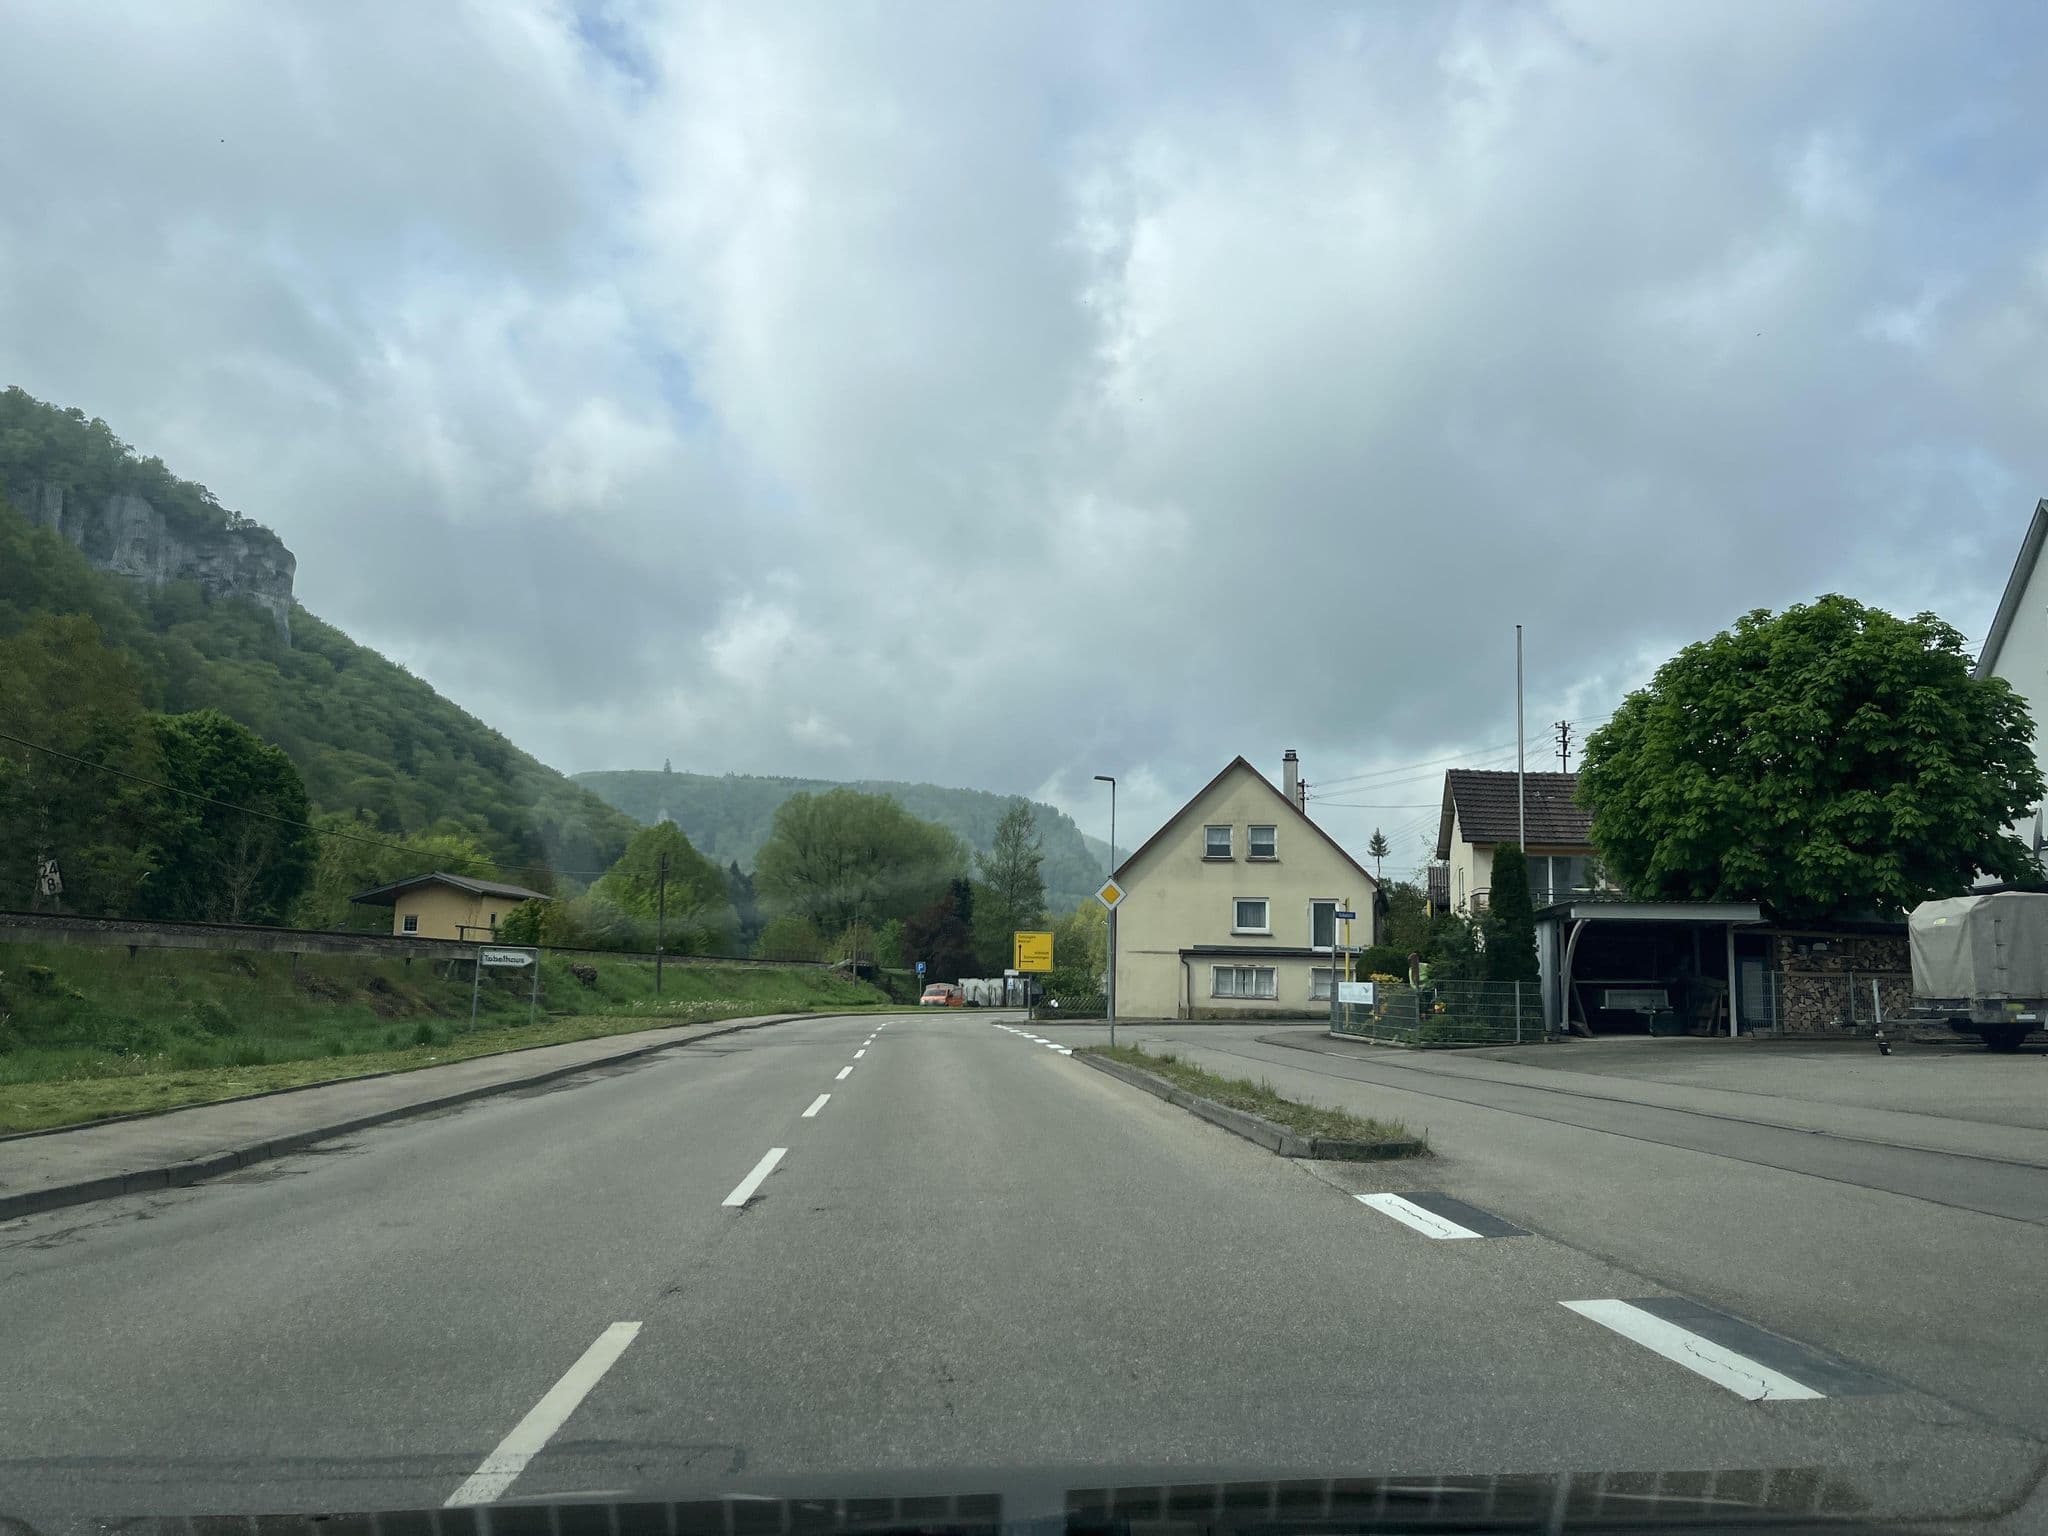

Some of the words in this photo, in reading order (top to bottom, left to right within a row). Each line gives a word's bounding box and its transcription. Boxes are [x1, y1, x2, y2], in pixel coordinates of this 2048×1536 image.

[39, 862, 59, 878] 24
[47, 878, 57, 891] 8
[918, 963, 923, 971] P
